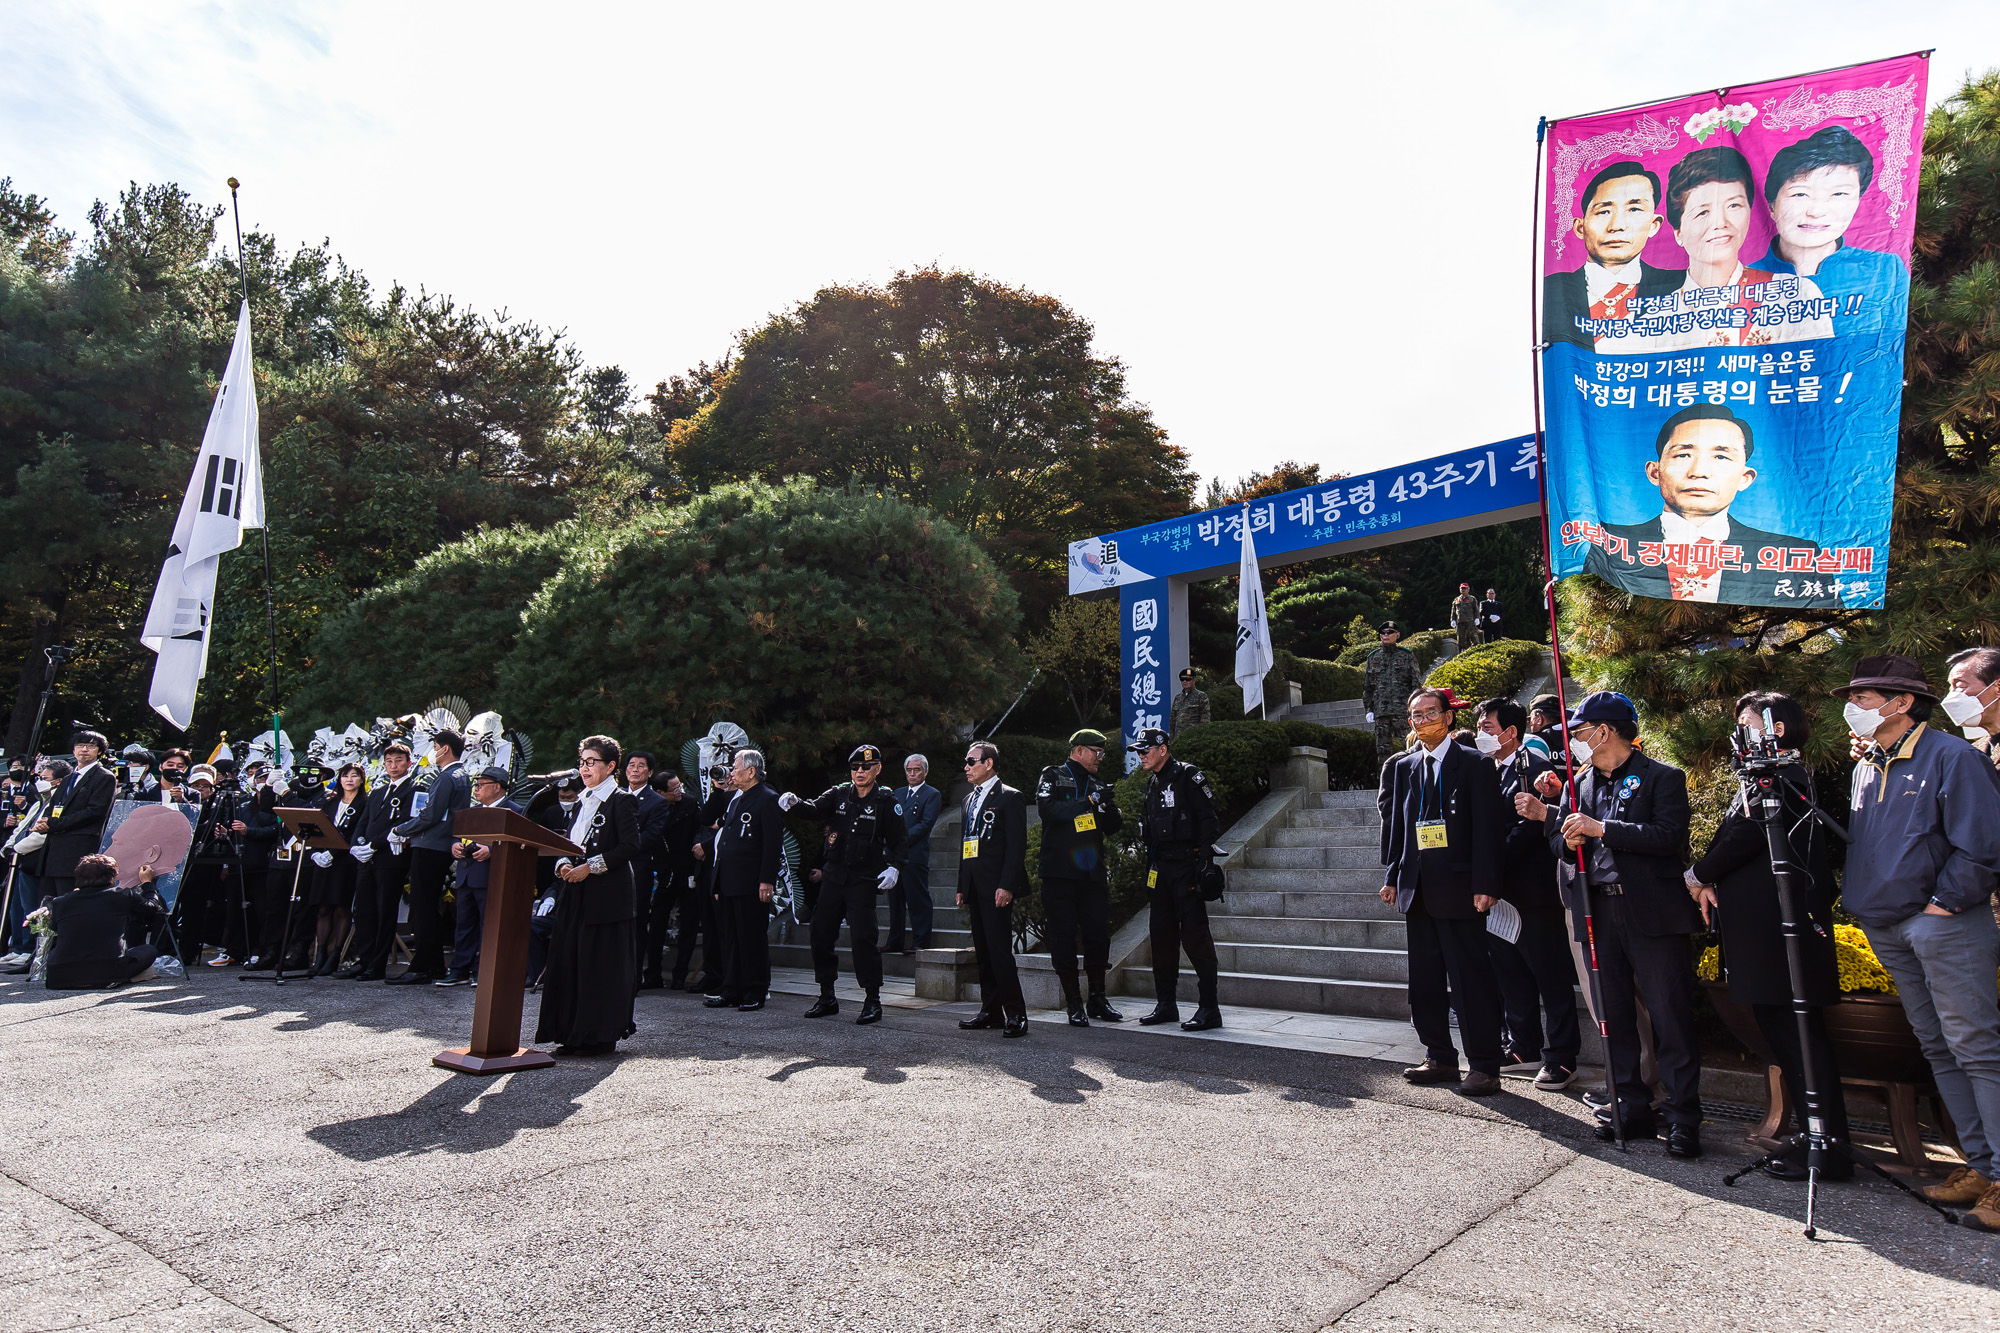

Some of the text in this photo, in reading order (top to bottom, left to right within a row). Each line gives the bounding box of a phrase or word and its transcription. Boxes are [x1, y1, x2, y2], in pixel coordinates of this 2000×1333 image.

[1626, 277, 1799, 315] 박정희 박근혜 대통령
[1697, 307, 1748, 330] 정신을
[1595, 349, 1817, 382] 한강의 기적!! 새마을운동
[1574, 374, 1636, 409] 박정희
[1647, 380, 1757, 407] 대통령의
[1767, 376, 1823, 404] 눈물
[1197, 502, 1276, 547] 박정희
[1287, 479, 1376, 526] 대통령
[1388, 451, 1497, 503] 43주기
[1140, 523, 1191, 546] 부국강병의
[1312, 525, 1334, 540] 주관
[1345, 511, 1401, 534] 민족중흥회
[1100, 541, 1118, 567] 追
[1170, 538, 1192, 552] 국부
[1756, 546, 1874, 574] 외교실패
